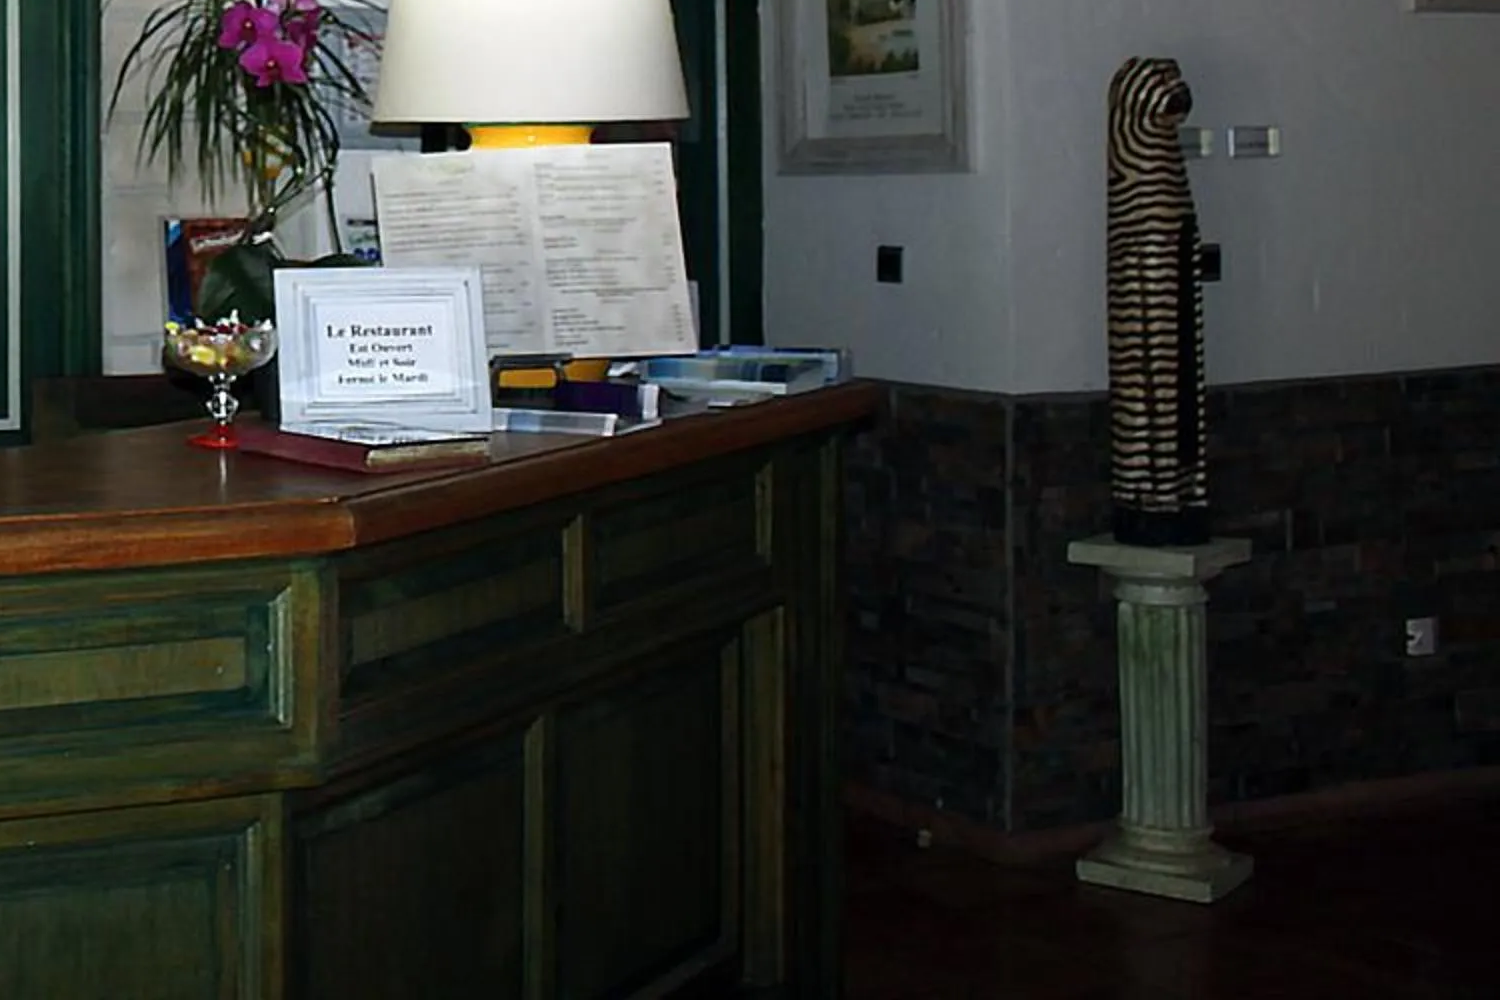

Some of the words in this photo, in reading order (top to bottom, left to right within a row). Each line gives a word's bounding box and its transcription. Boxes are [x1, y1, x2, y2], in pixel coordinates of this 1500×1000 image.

[327, 324, 345, 338] Le
[351, 324, 433, 337] Restaurant
[371, 343, 413, 353] Ouvert
